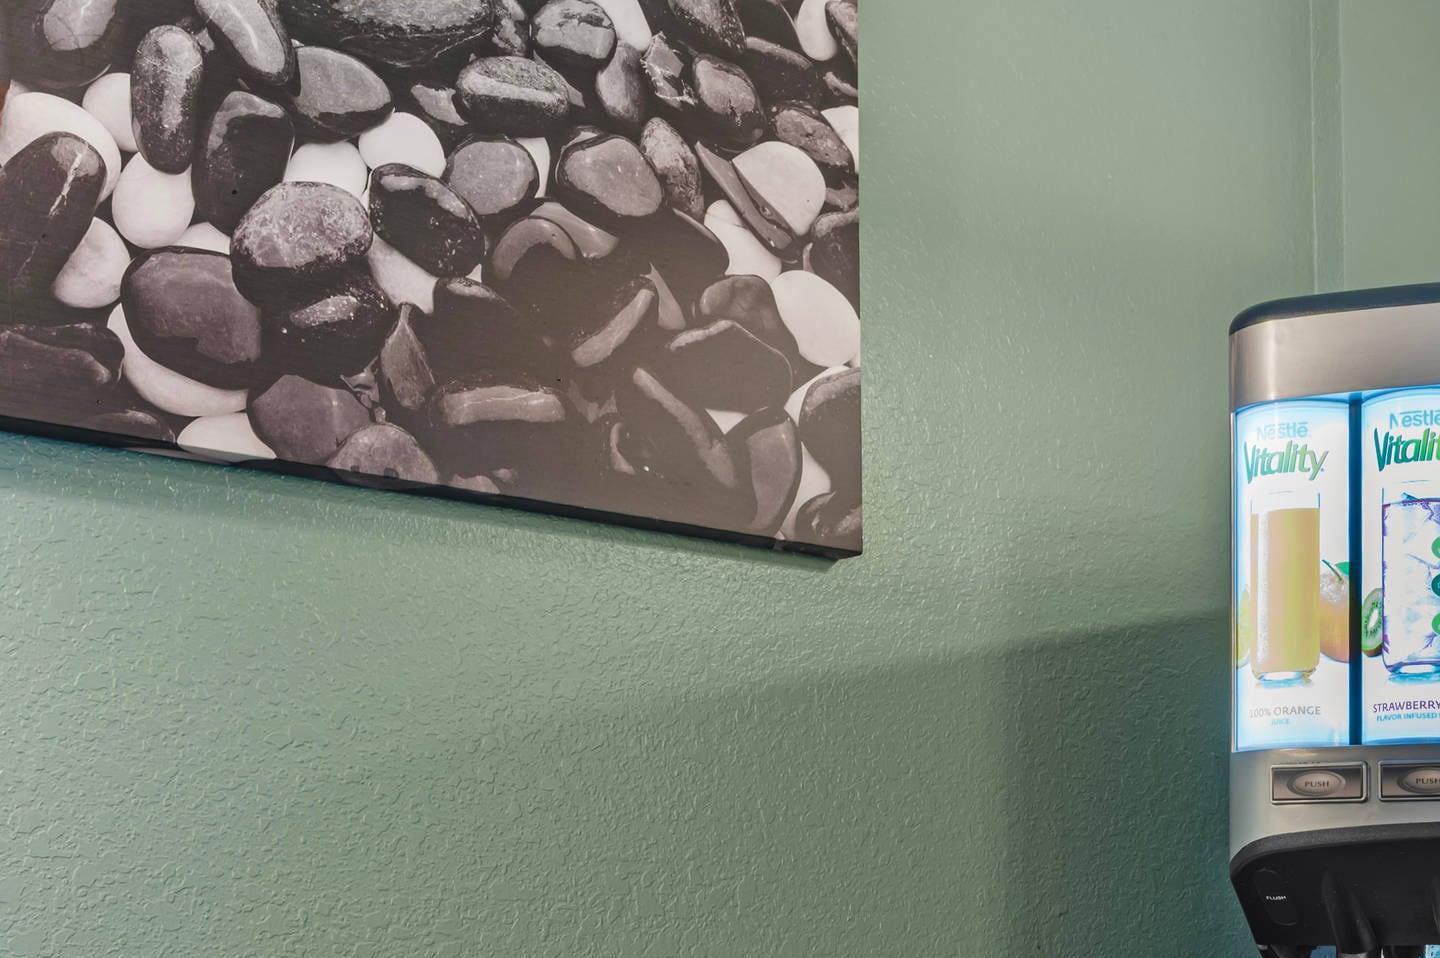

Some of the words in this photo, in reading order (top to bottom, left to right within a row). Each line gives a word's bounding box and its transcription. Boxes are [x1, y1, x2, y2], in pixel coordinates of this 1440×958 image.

[1243, 440, 1329, 484] Vitality
[1250, 707, 1272, 720] 100%
[1273, 705, 1321, 717] ORANGE
[1377, 714, 1403, 722] FLAVOR
[1403, 712, 1438, 720] INFUSED
[1304, 780, 1330, 788] PUSH
